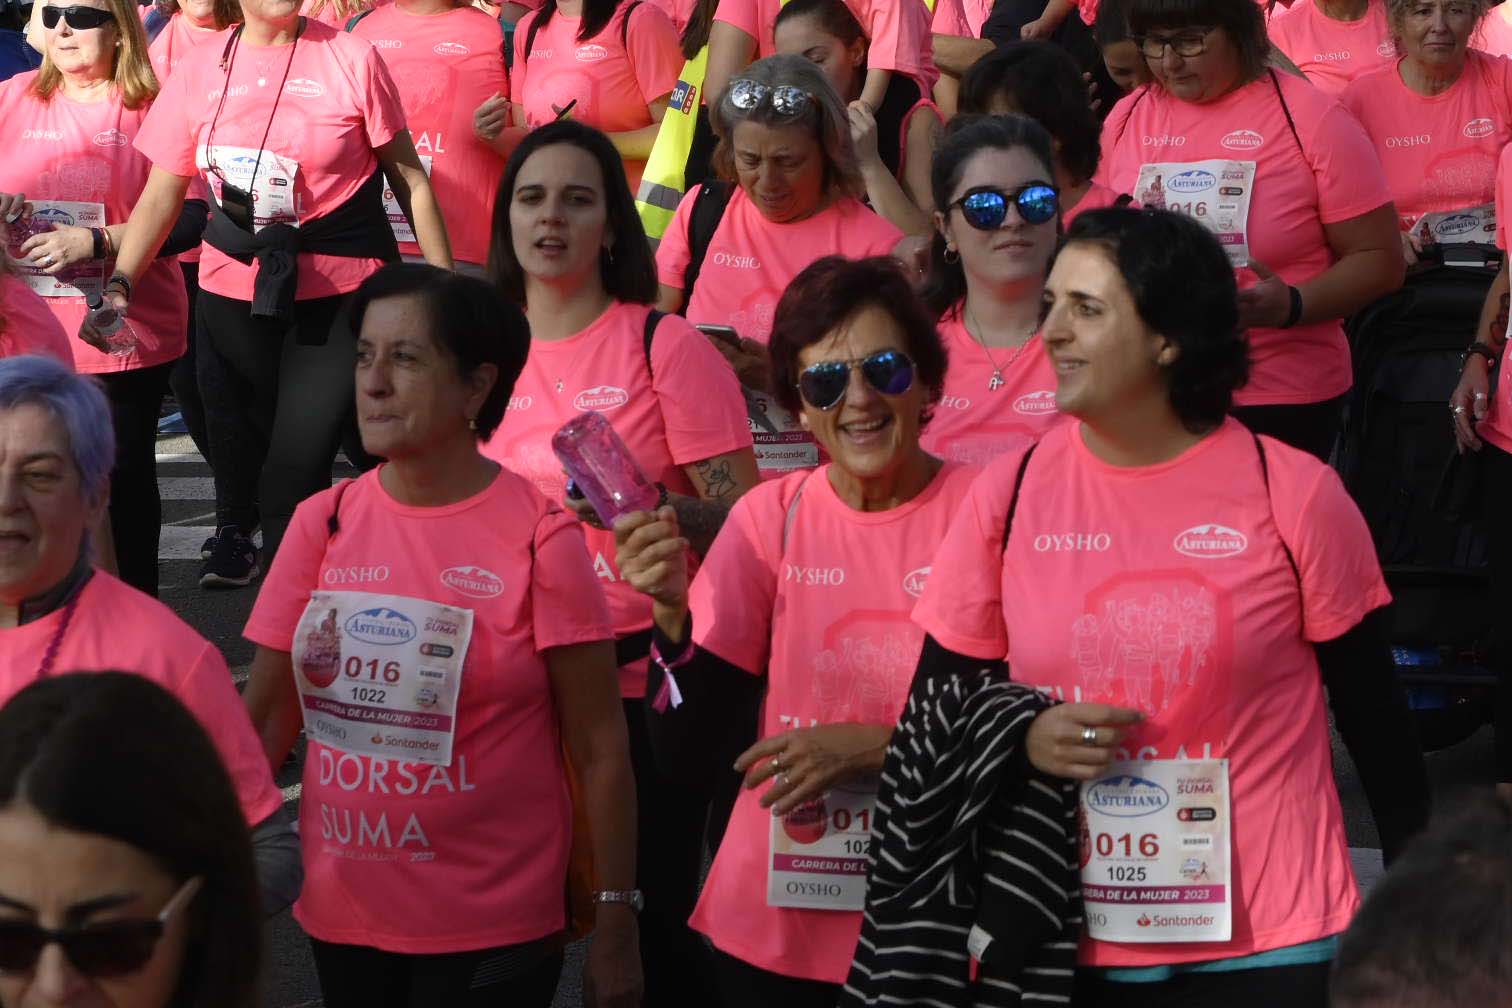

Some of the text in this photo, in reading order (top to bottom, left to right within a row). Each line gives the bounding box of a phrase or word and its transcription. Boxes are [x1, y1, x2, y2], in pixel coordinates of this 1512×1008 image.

[1385, 134, 1432, 149] OYSHO
[765, 450, 808, 460] Santander
[1033, 533, 1112, 553] OYSHO
[1179, 536, 1243, 552] ASTURIANA
[324, 565, 391, 585] OYSHO
[350, 618, 411, 639] ASTURIANA
[424, 622, 458, 636] SUMA
[344, 655, 401, 684] 016
[351, 686, 387, 704] 1022
[348, 706, 361, 719] DE
[362, 709, 376, 720] LA
[377, 711, 411, 724] MUJER
[414, 715, 439, 727] 2023
[384, 735, 440, 752] Santander
[319, 748, 477, 795] DORSAL
[1177, 784, 1214, 795] SUMA
[1092, 791, 1162, 807] ASTURIANA
[320, 802, 431, 849] SUMA
[833, 808, 870, 832] 01
[844, 839, 871, 854] 102
[1095, 832, 1160, 858] 016
[791, 859, 841, 871] CARRERA
[843, 863, 858, 872] DE
[1107, 866, 1147, 882] 1025
[786, 881, 842, 897] OYSHO
[1107, 890, 1121, 900] DE
[1122, 890, 1137, 900] LA
[1141, 889, 1180, 901] MUJER
[1184, 889, 1210, 900] 2023
[1153, 914, 1214, 929] Santander
